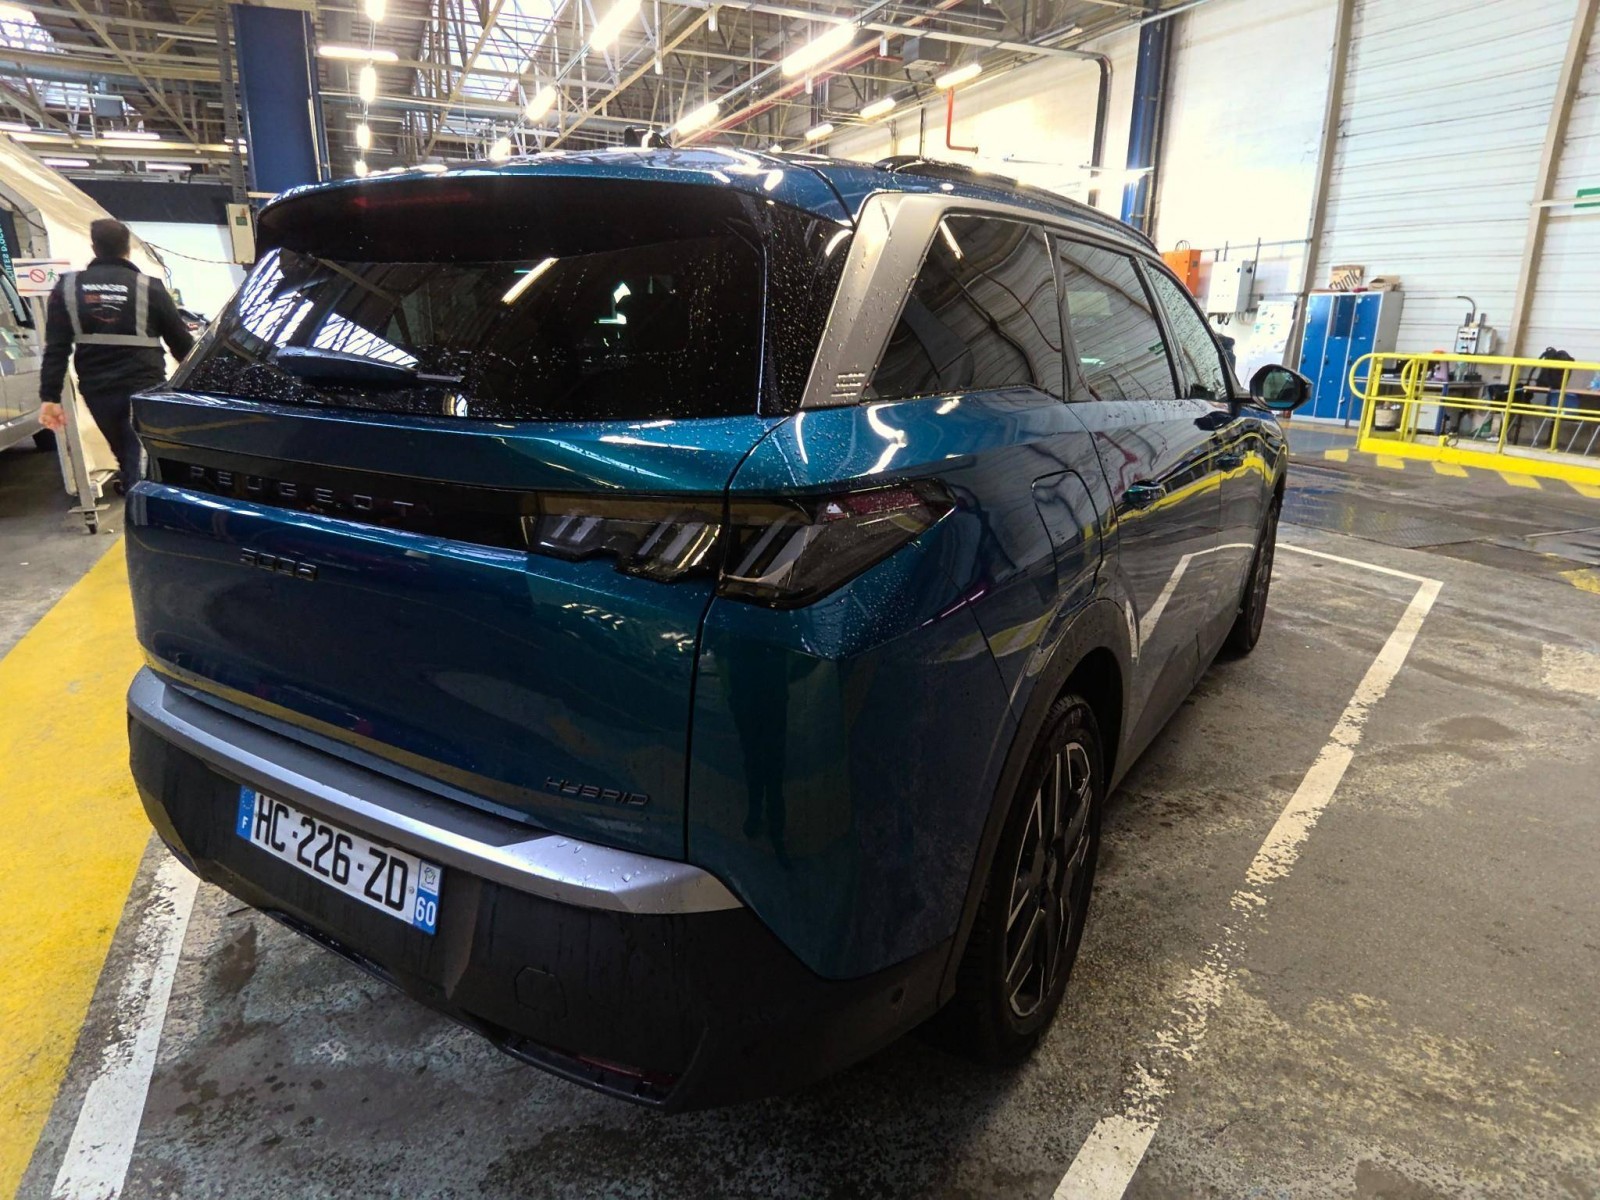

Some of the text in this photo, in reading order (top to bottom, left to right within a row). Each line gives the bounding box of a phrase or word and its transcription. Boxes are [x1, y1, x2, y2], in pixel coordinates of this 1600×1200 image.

[190, 466, 415, 517] PEUGEOT
[545, 776, 649, 805] HYBRID
[242, 794, 437, 927] F HC-226-ZD 60
